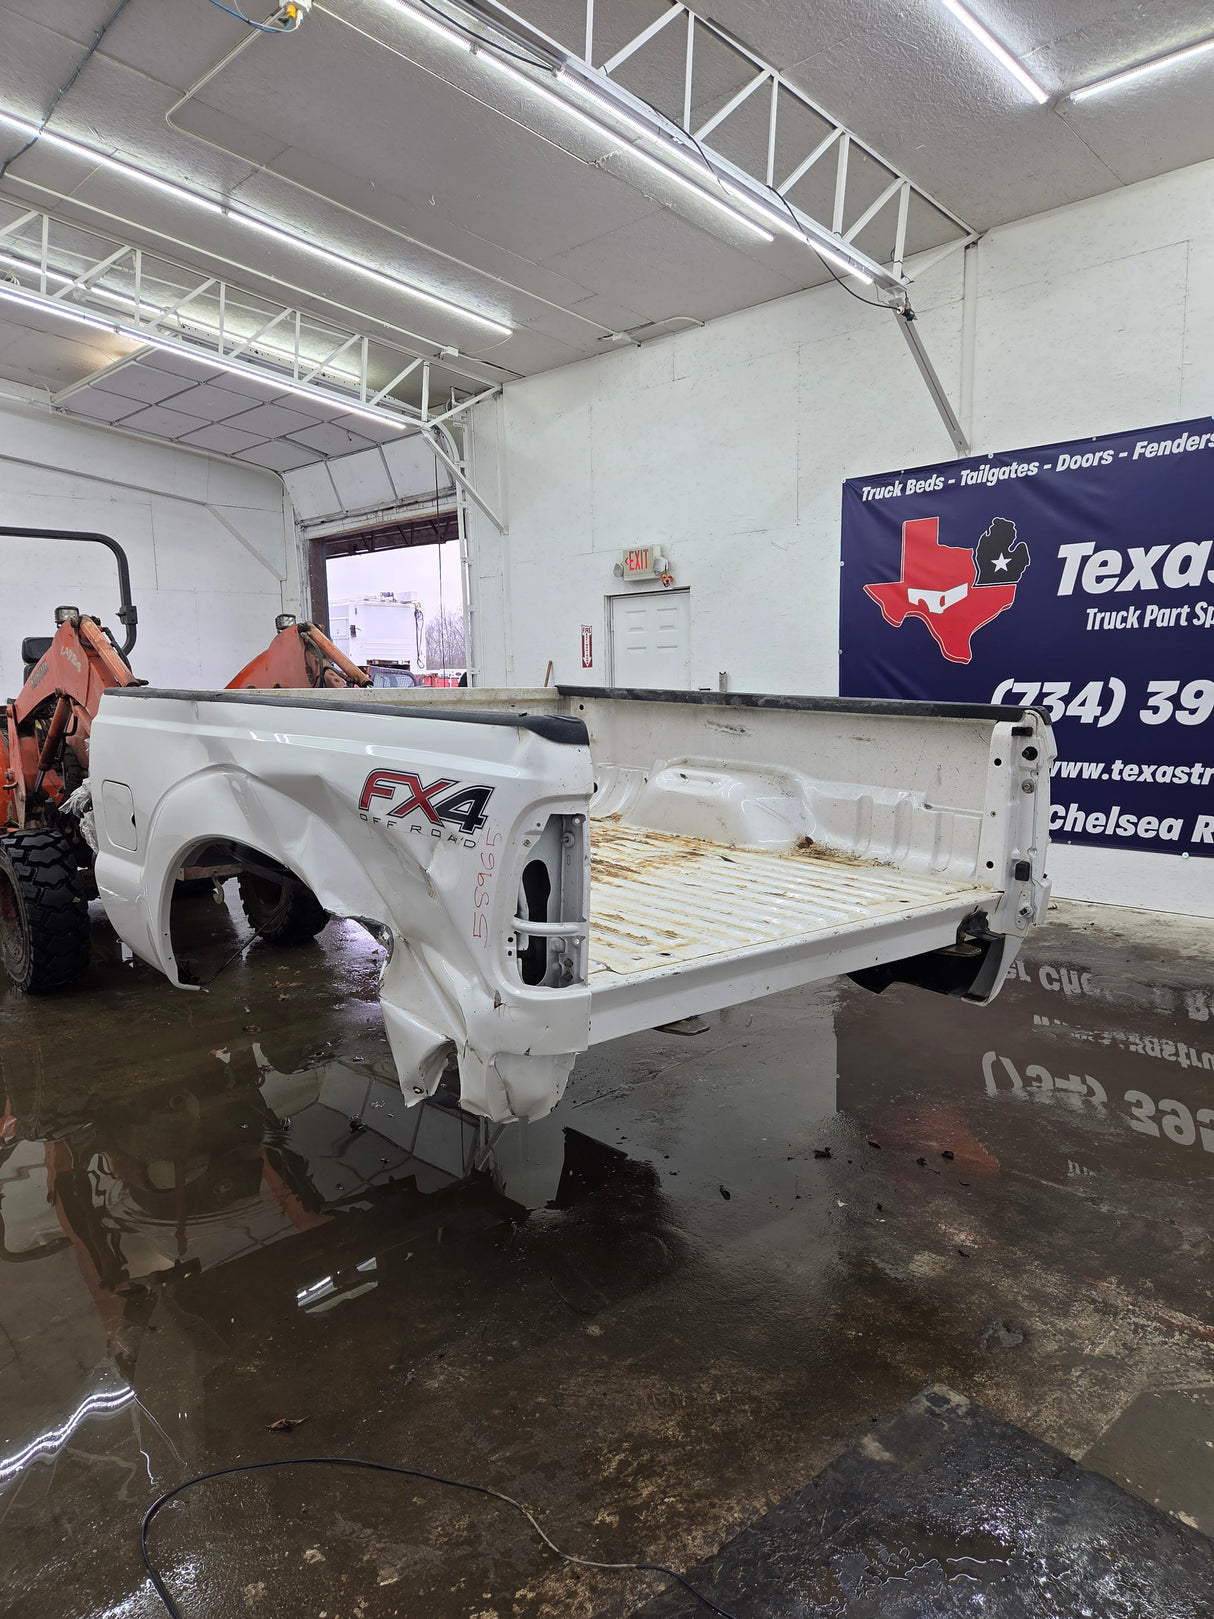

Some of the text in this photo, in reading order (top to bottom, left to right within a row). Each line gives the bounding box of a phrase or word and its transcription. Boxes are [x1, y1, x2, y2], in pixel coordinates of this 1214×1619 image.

[861, 480, 903, 502] Truck
[905, 474, 945, 496] Beds
[960, 461, 1040, 487] Tailgates
[1056, 450, 1115, 472] Doors
[628, 548, 649, 571] EXIT
[1057, 540, 1214, 597] Texa
[1086, 606, 1142, 631] Truck
[1143, 604, 1191, 628] Part
[358, 767, 496, 836] FX4
[1050, 803, 1184, 841] Chelsea
